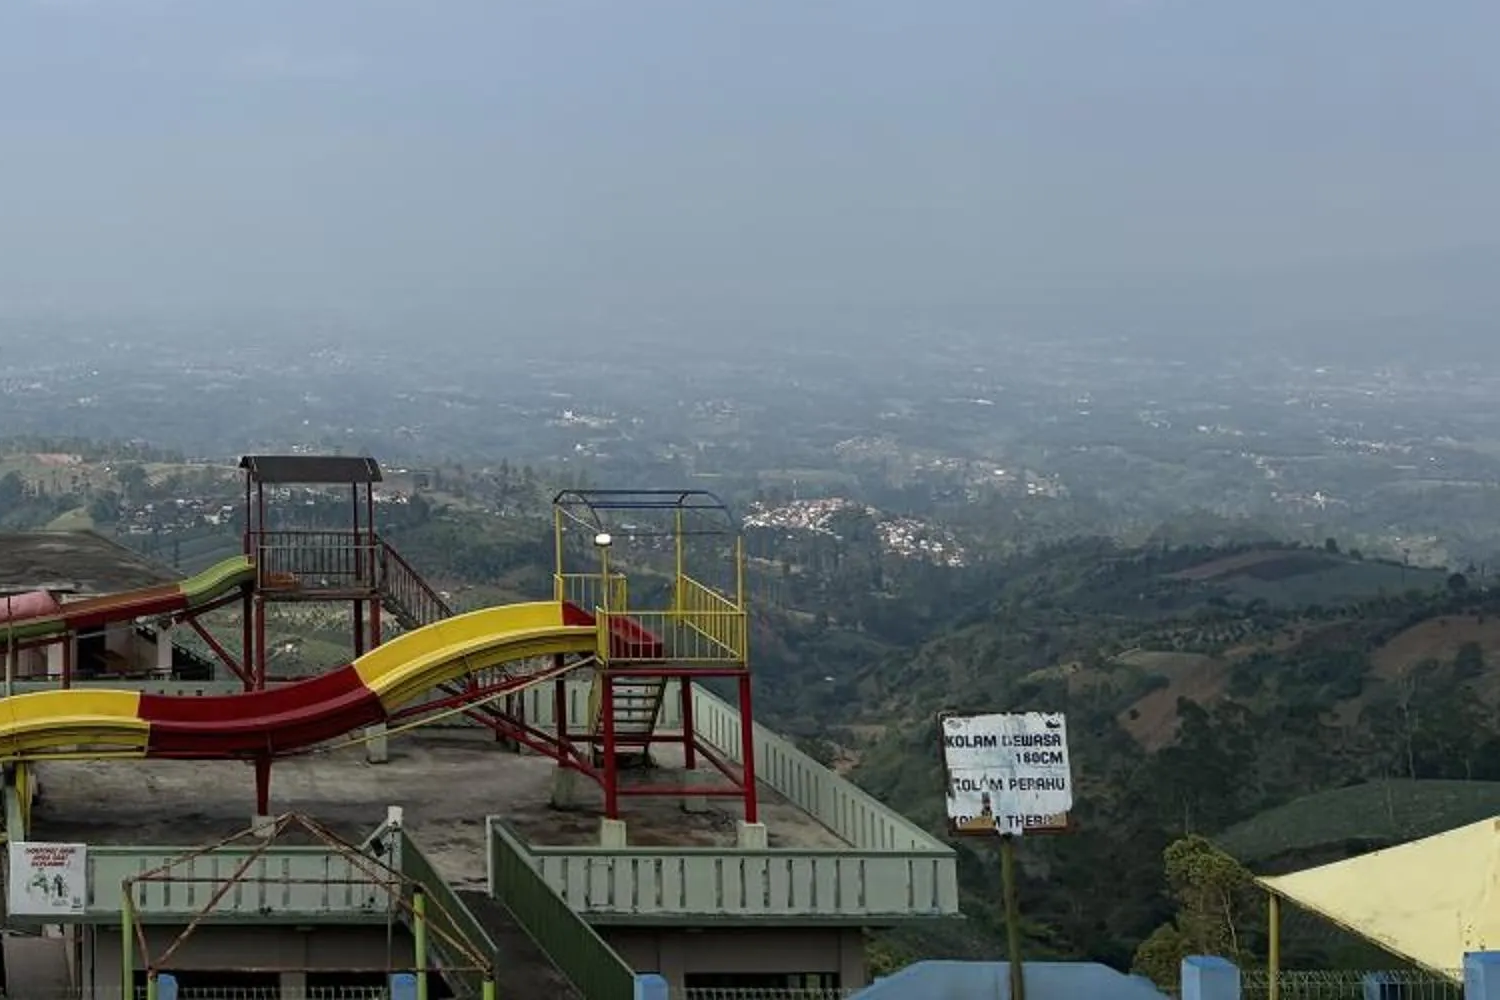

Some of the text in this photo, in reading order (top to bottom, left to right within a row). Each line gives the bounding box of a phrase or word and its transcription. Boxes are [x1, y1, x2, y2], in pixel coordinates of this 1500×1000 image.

[945, 735, 997, 748] KOLAM
[1015, 751, 1063, 764] 180CM
[1009, 777, 1065, 791] PERAHU
